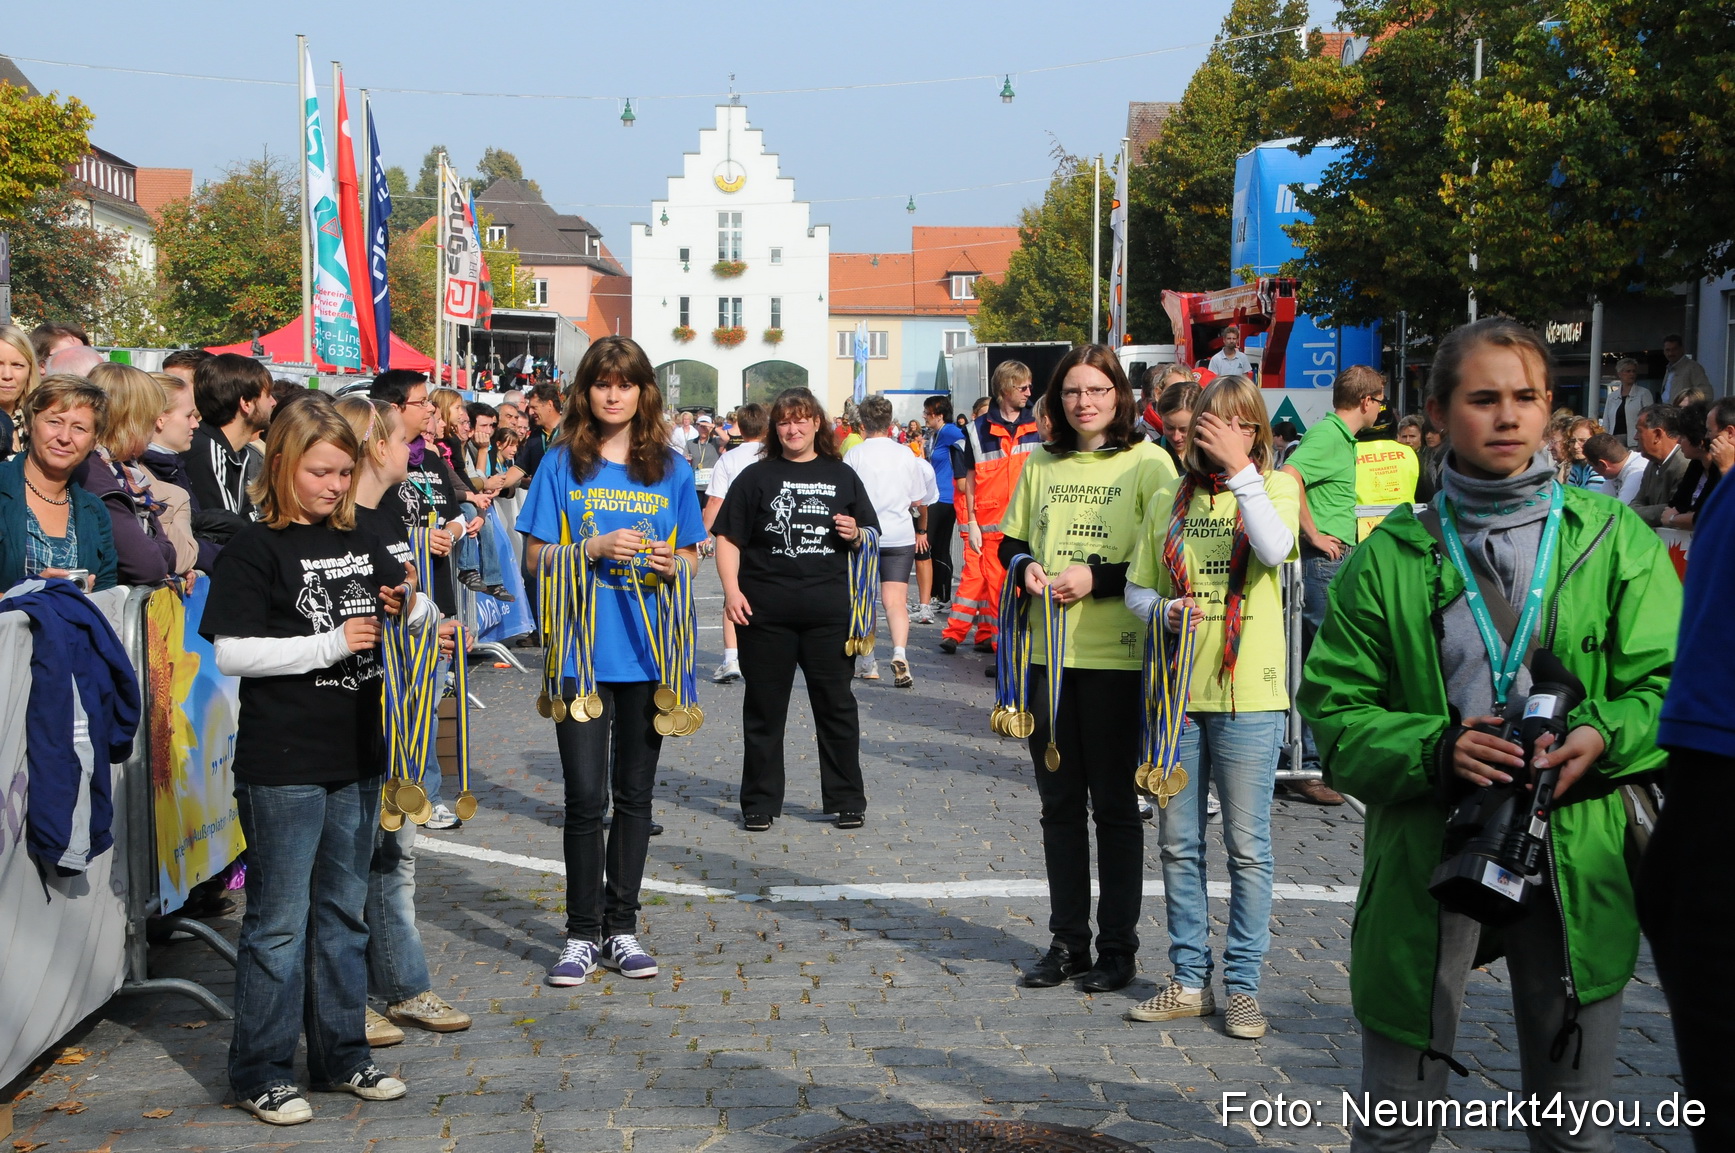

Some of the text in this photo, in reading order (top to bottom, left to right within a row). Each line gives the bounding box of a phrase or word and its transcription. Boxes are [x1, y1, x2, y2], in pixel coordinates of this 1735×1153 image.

[328, 344, 359, 359] 6352
[1356, 451, 1406, 465] HELFER
[783, 481, 836, 491] Neumarkter
[1047, 485, 1121, 497] NEUMARKTER
[569, 488, 669, 509] 10. NEUMARKTER
[1050, 494, 1113, 505] STADTLAUF
[584, 499, 658, 515] STADTLAUF
